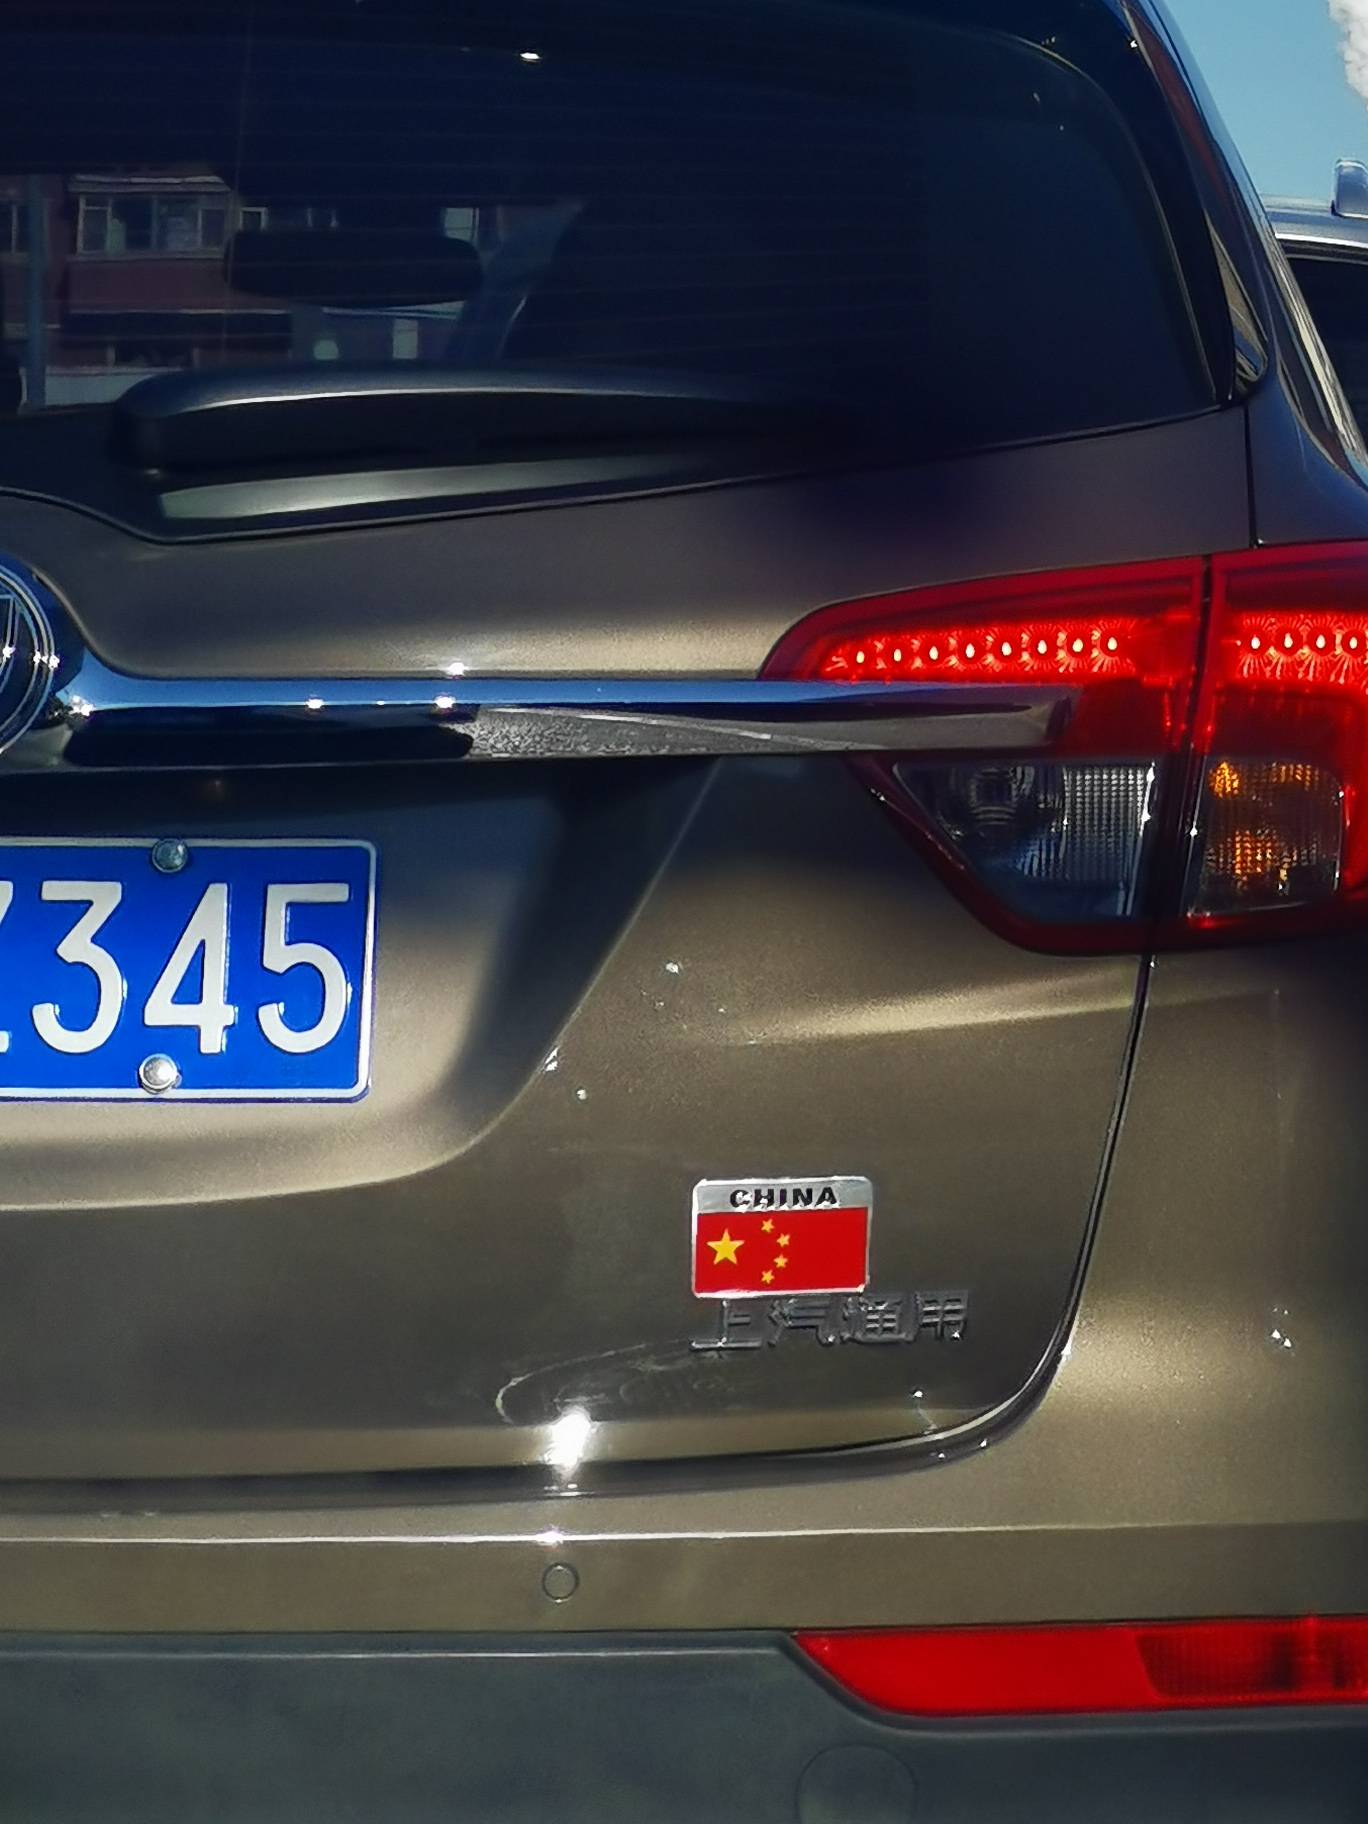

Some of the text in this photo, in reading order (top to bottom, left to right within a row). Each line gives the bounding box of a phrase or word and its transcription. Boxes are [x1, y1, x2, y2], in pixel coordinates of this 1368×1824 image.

[0, 880, 352, 1054] 345
[729, 1186, 840, 1211] CHINA
[688, 1289, 969, 1352] 上汽通用
